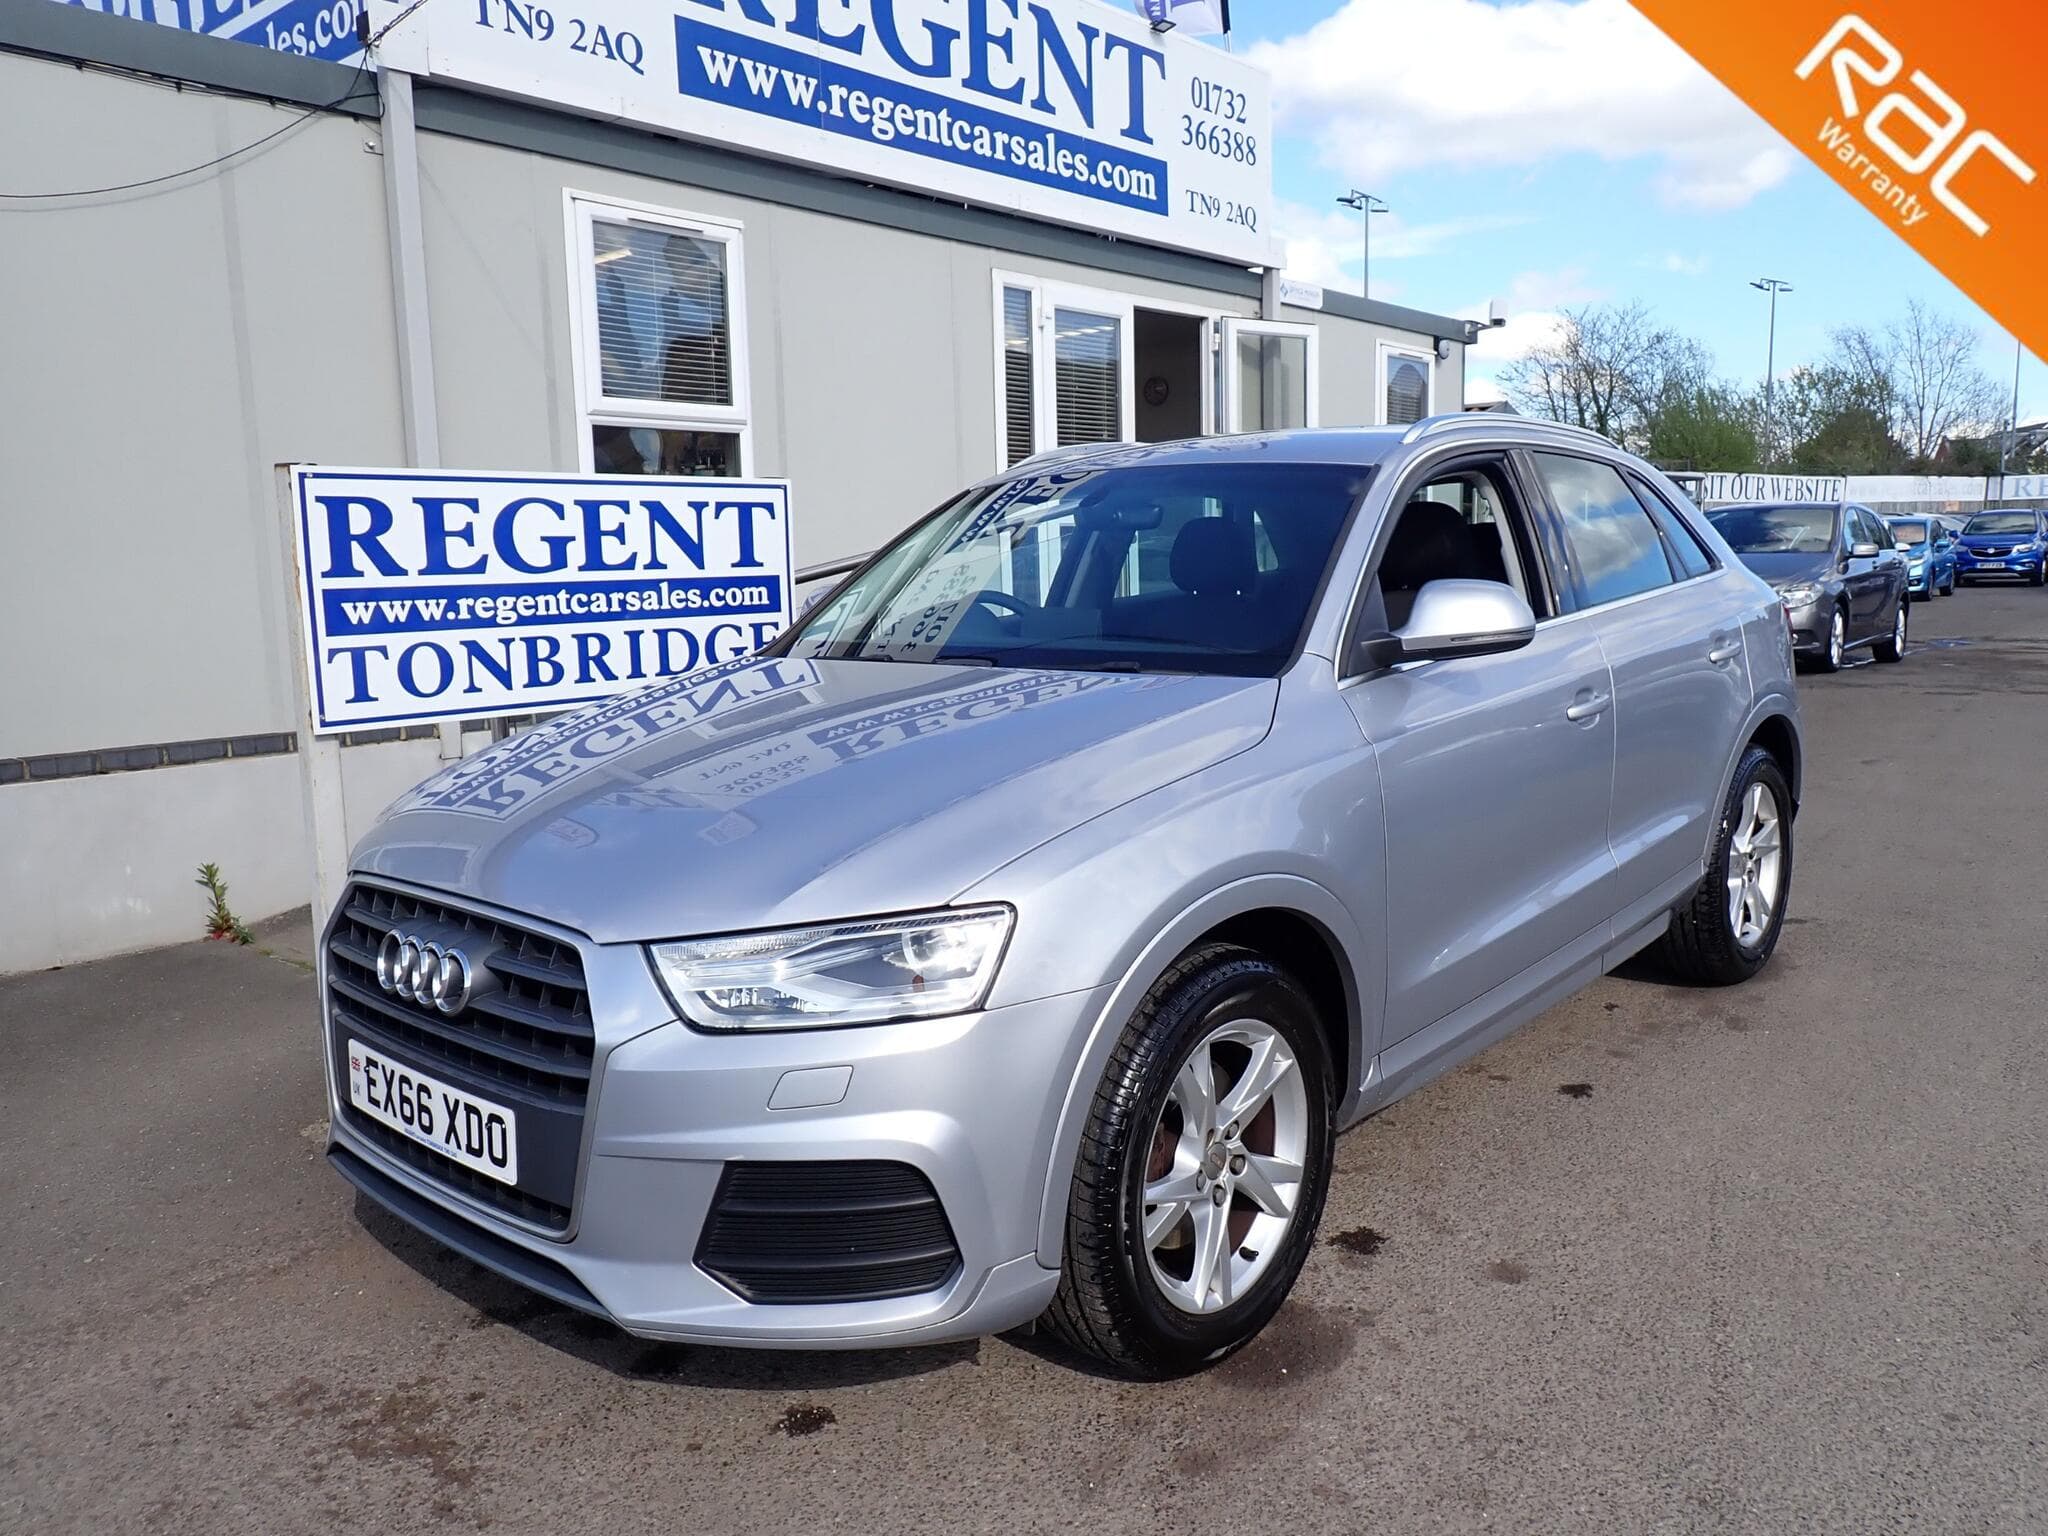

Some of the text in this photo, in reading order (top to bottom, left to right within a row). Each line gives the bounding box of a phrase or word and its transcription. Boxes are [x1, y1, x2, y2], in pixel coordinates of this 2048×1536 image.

[476, 0, 645, 76] TN9 2AQ
[686, 0, 1166, 146] GENT
[1191, 76, 1247, 124] 01732
[696, 44, 1158, 201] www.regentcarsales.com
[1181, 114, 1257, 166] 366388
[1185, 189, 1257, 234] TN9 2AQ
[1731, 475, 1766, 500] OUR
[1770, 477, 1842, 502] WEBSITE
[314, 495, 776, 579] REGENT
[341, 581, 770, 624] www.regentcarsales.com
[364, 1055, 434, 1136] EX66
[442, 1093, 508, 1169] XDO
